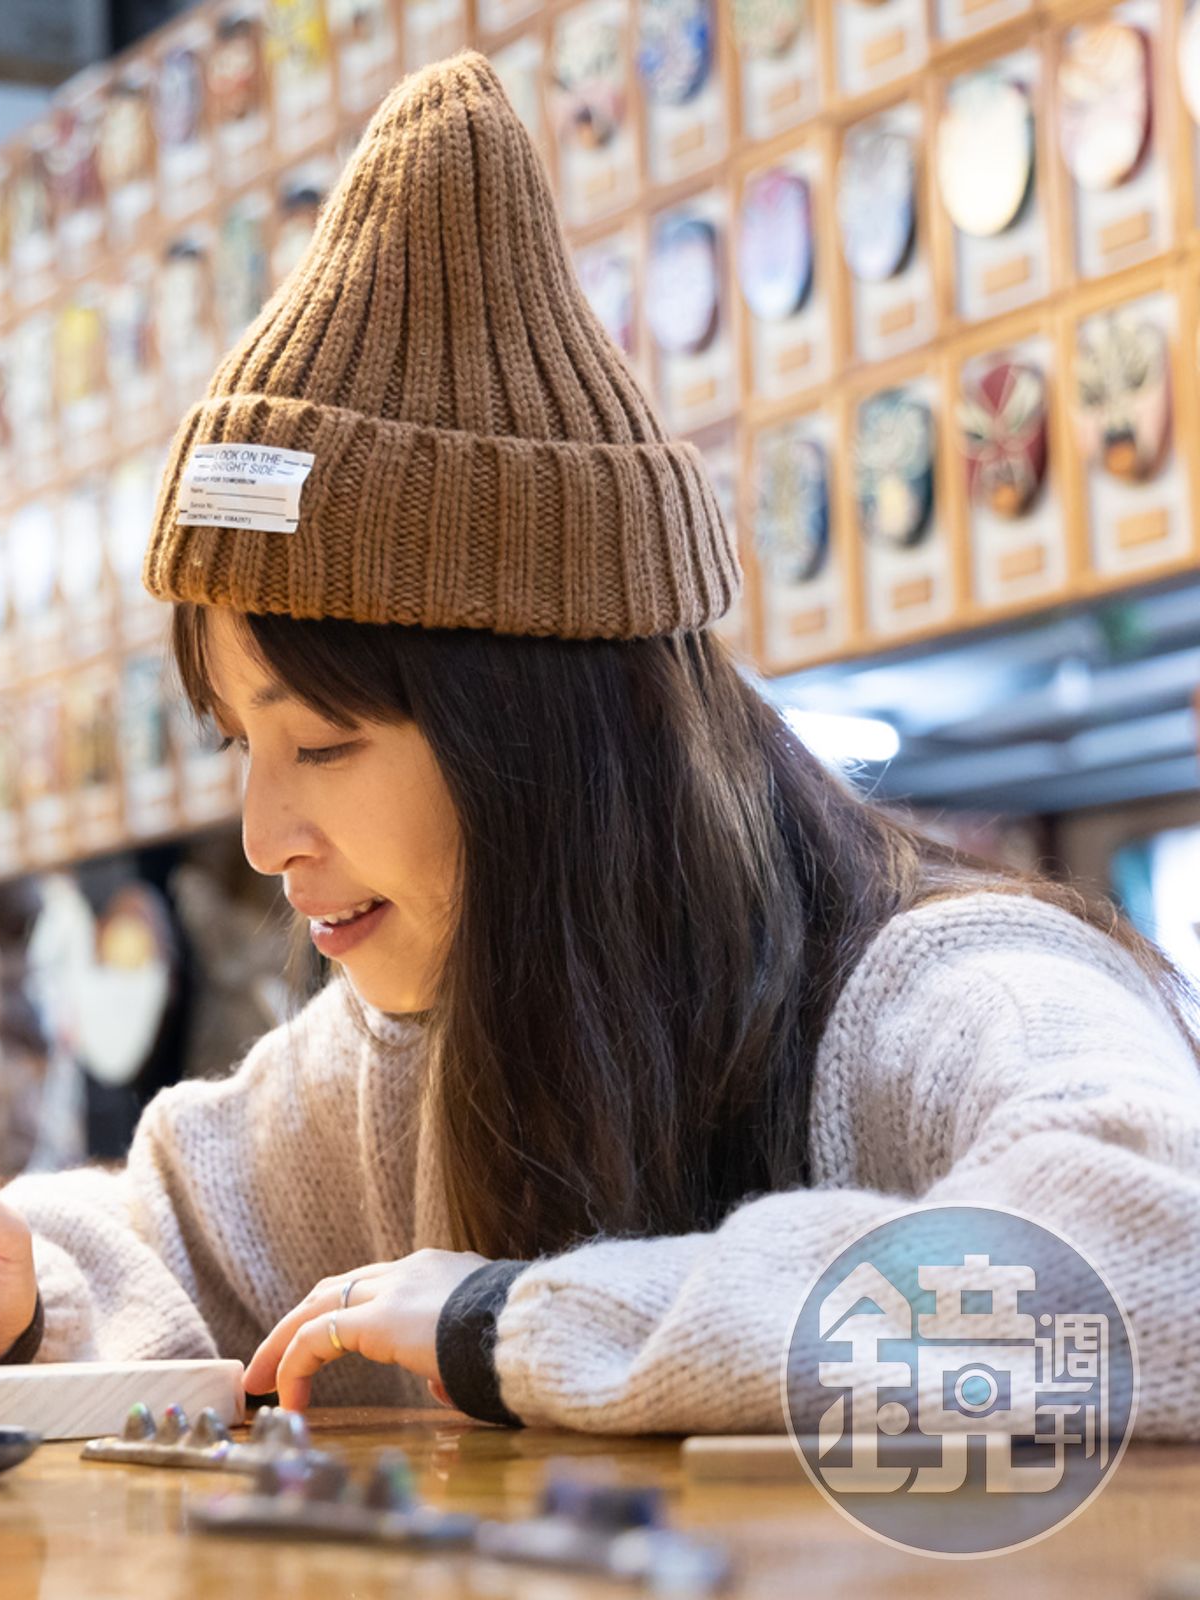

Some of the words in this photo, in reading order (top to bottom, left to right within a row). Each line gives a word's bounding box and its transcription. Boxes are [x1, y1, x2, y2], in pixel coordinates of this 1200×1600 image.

[241, 451, 258, 462] ON
[260, 452, 283, 465] THE
[248, 463, 277, 476] SIDE
